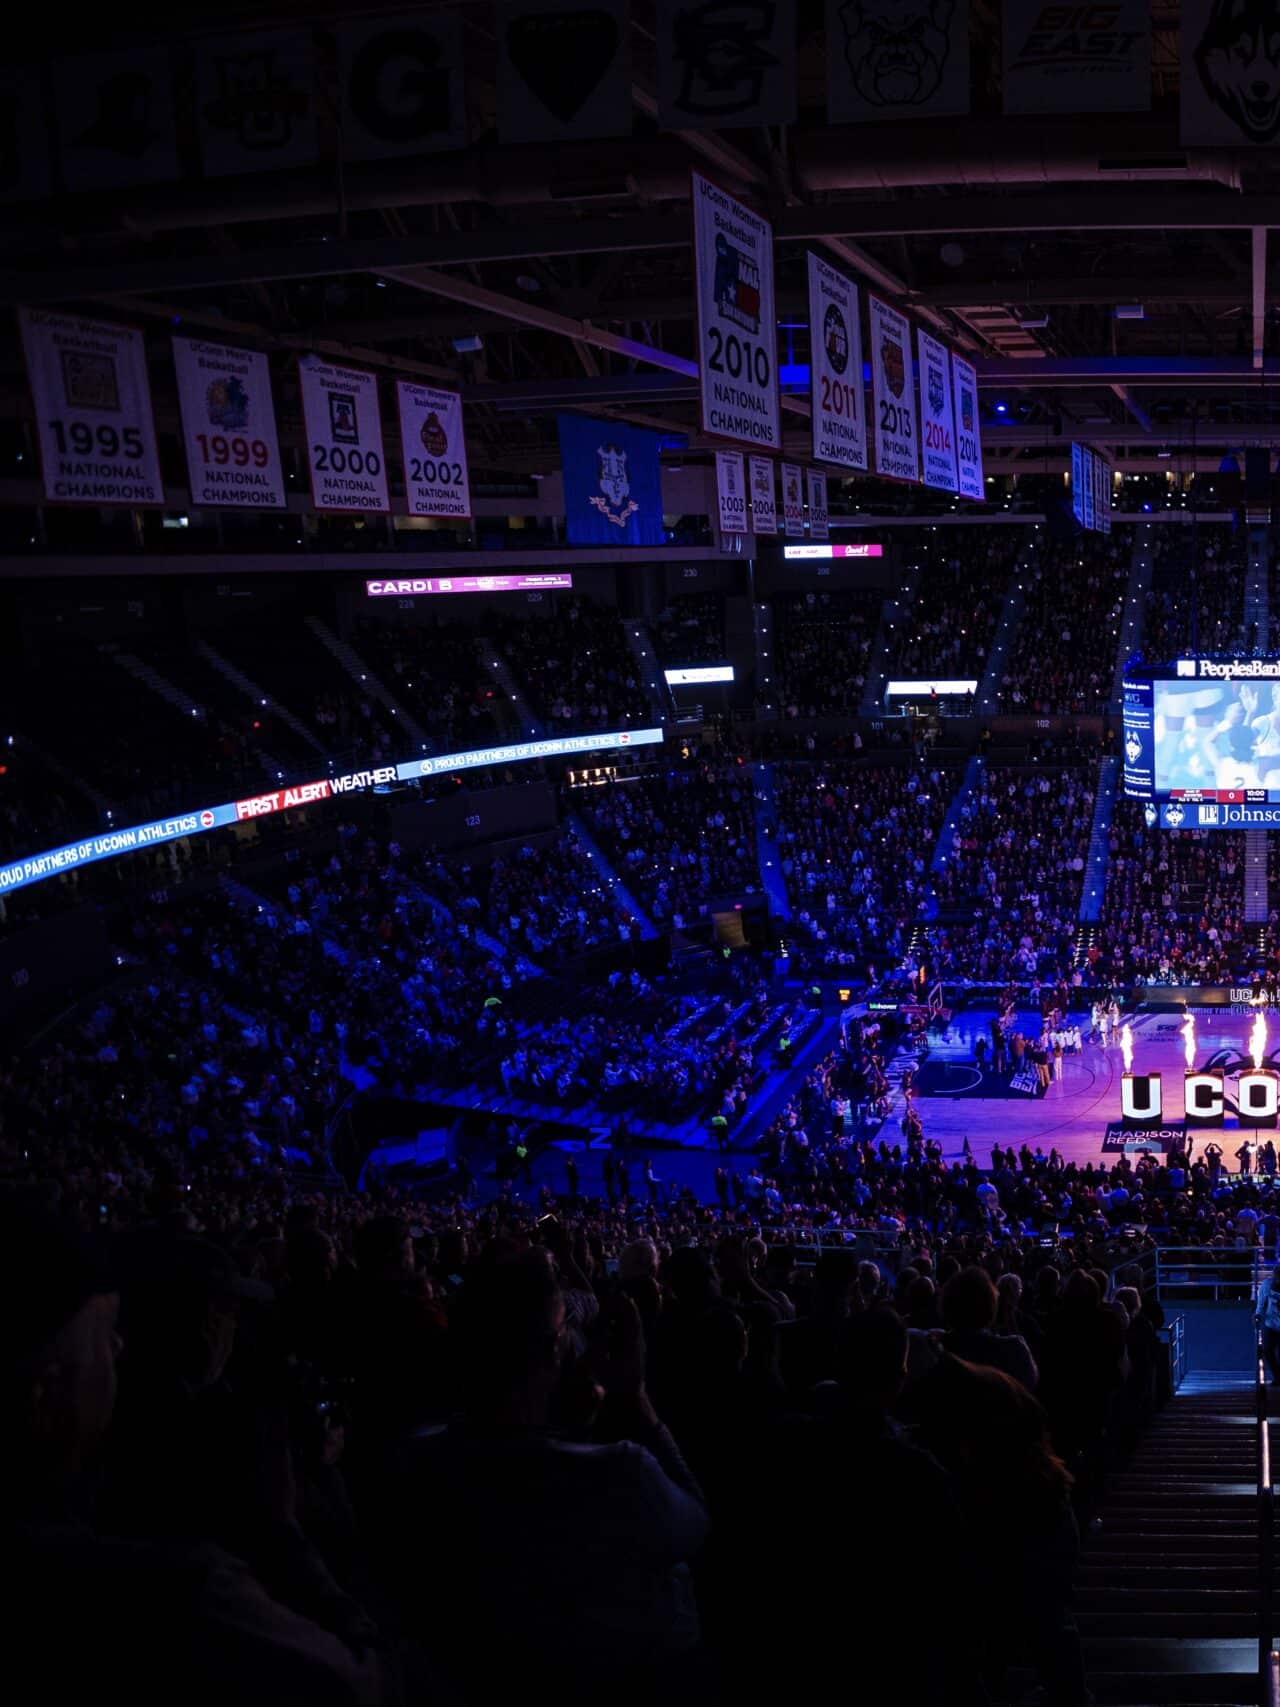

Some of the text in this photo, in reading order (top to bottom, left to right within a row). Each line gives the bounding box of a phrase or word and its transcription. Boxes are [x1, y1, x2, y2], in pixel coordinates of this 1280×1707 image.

[1018, 33, 1139, 57] EAST
[349, 27, 450, 143] G
[700, 181, 767, 235] UConn Women's
[714, 211, 758, 249] Basketball
[708, 327, 770, 389] 2010
[713, 384, 769, 416] NATIONAL
[821, 376, 857, 421] 2011
[709, 410, 774, 442] CHAMPIONS
[822, 418, 858, 443] NATIONAL
[879, 400, 912, 438] 2013
[50, 419, 145, 460] 1995
[882, 438, 913, 459] NATIONAL
[925, 420, 952, 453] 2014
[197, 433, 269, 469] 1999
[314, 444, 381, 477] 2000
[820, 440, 864, 465] CHAMPIONS
[59, 463, 146, 480] NATIONAL
[205, 470, 271, 487] NATIONAL
[410, 458, 465, 487] 2002
[54, 482, 155, 500] CHAMPIONS
[202, 487, 278, 504] CHAMPIONS
[323, 477, 378, 493] NATIONAL
[417, 487, 461, 501] NATIONAL
[321, 493, 383, 508] CHAMPIONS
[415, 501, 467, 514] CHAMPIONS
[720, 496, 745, 512] 2003
[753, 500, 775, 515] 2004
[368, 578, 433, 594] CARDI
[439, 578, 453, 592] B
[237, 765, 398, 820] FIRST ALERT WEATHER
[0, 816, 199, 888] OUD PARTNERS OF UCONN ATHLETICS
[1109, 1130, 1184, 1138] MADISON
